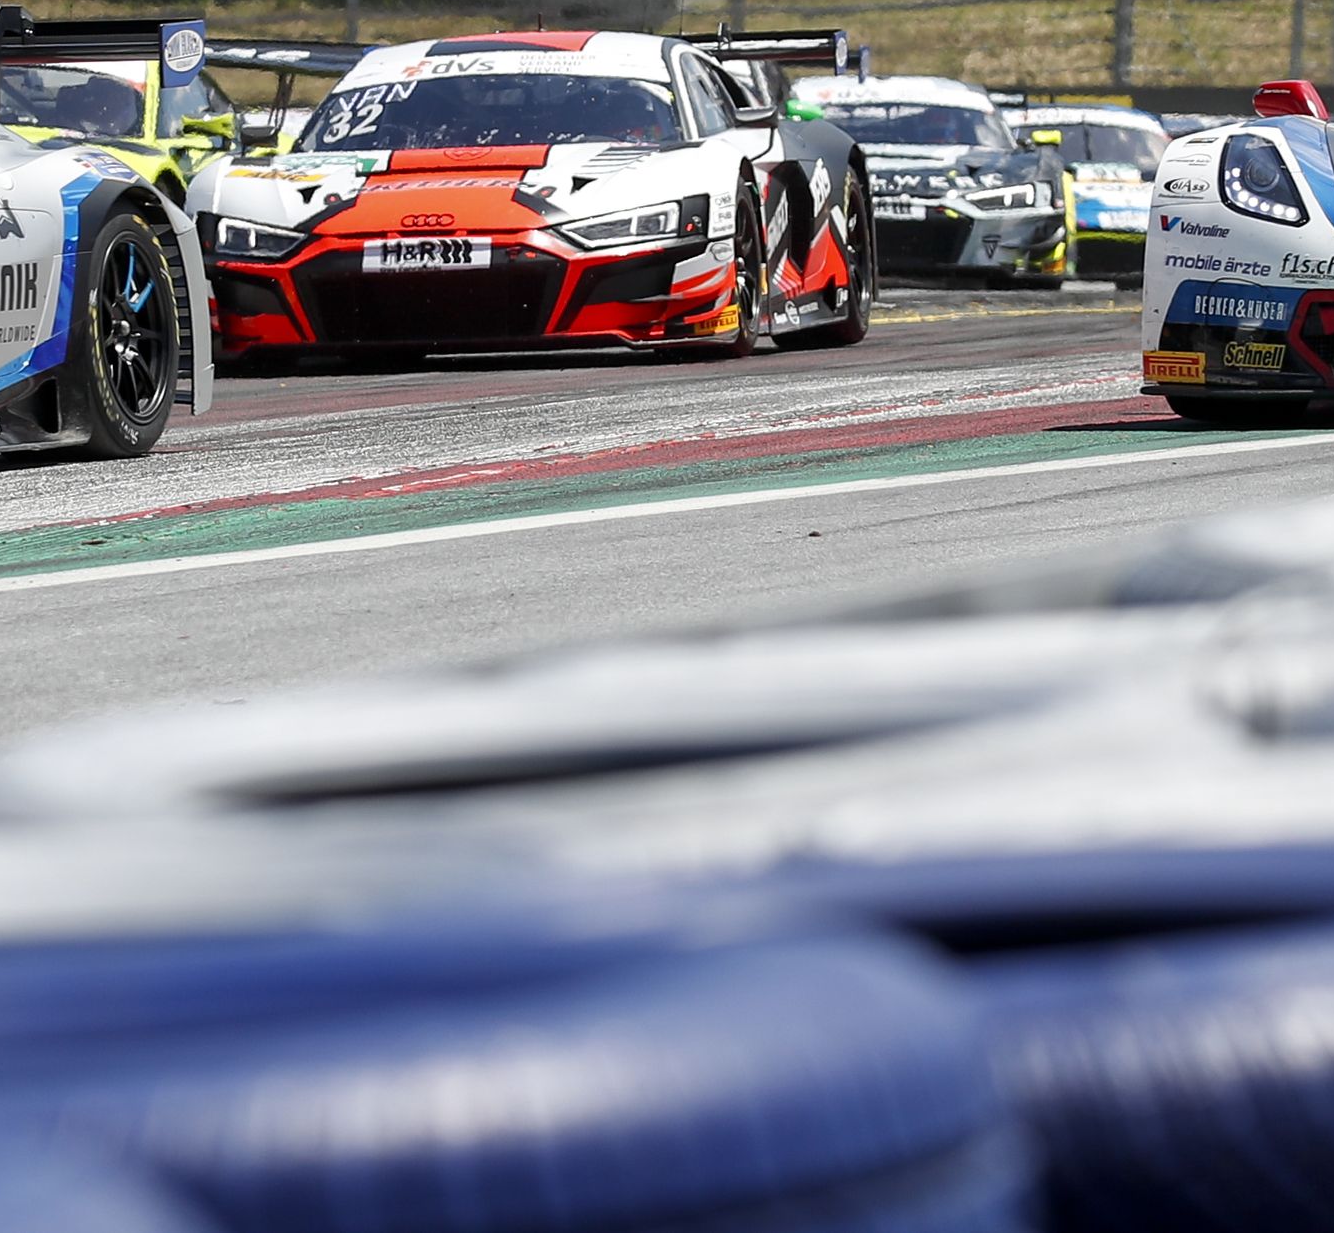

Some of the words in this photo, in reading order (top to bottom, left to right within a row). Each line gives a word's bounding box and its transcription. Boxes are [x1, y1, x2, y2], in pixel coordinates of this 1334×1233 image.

[431, 57, 495, 75] dvs
[338, 81, 418, 112] VAN
[322, 103, 384, 144] 32
[1180, 221, 1230, 239] Valvoline
[382, 241, 436, 264] H&R
[1165, 254, 1222, 272] mobile
[1223, 256, 1272, 277] ärzte
[1194, 295, 1285, 321] BECKER&HÜSER
[1143, 355, 1200, 378] PIRELLI
[1224, 342, 1286, 369] Schnell
